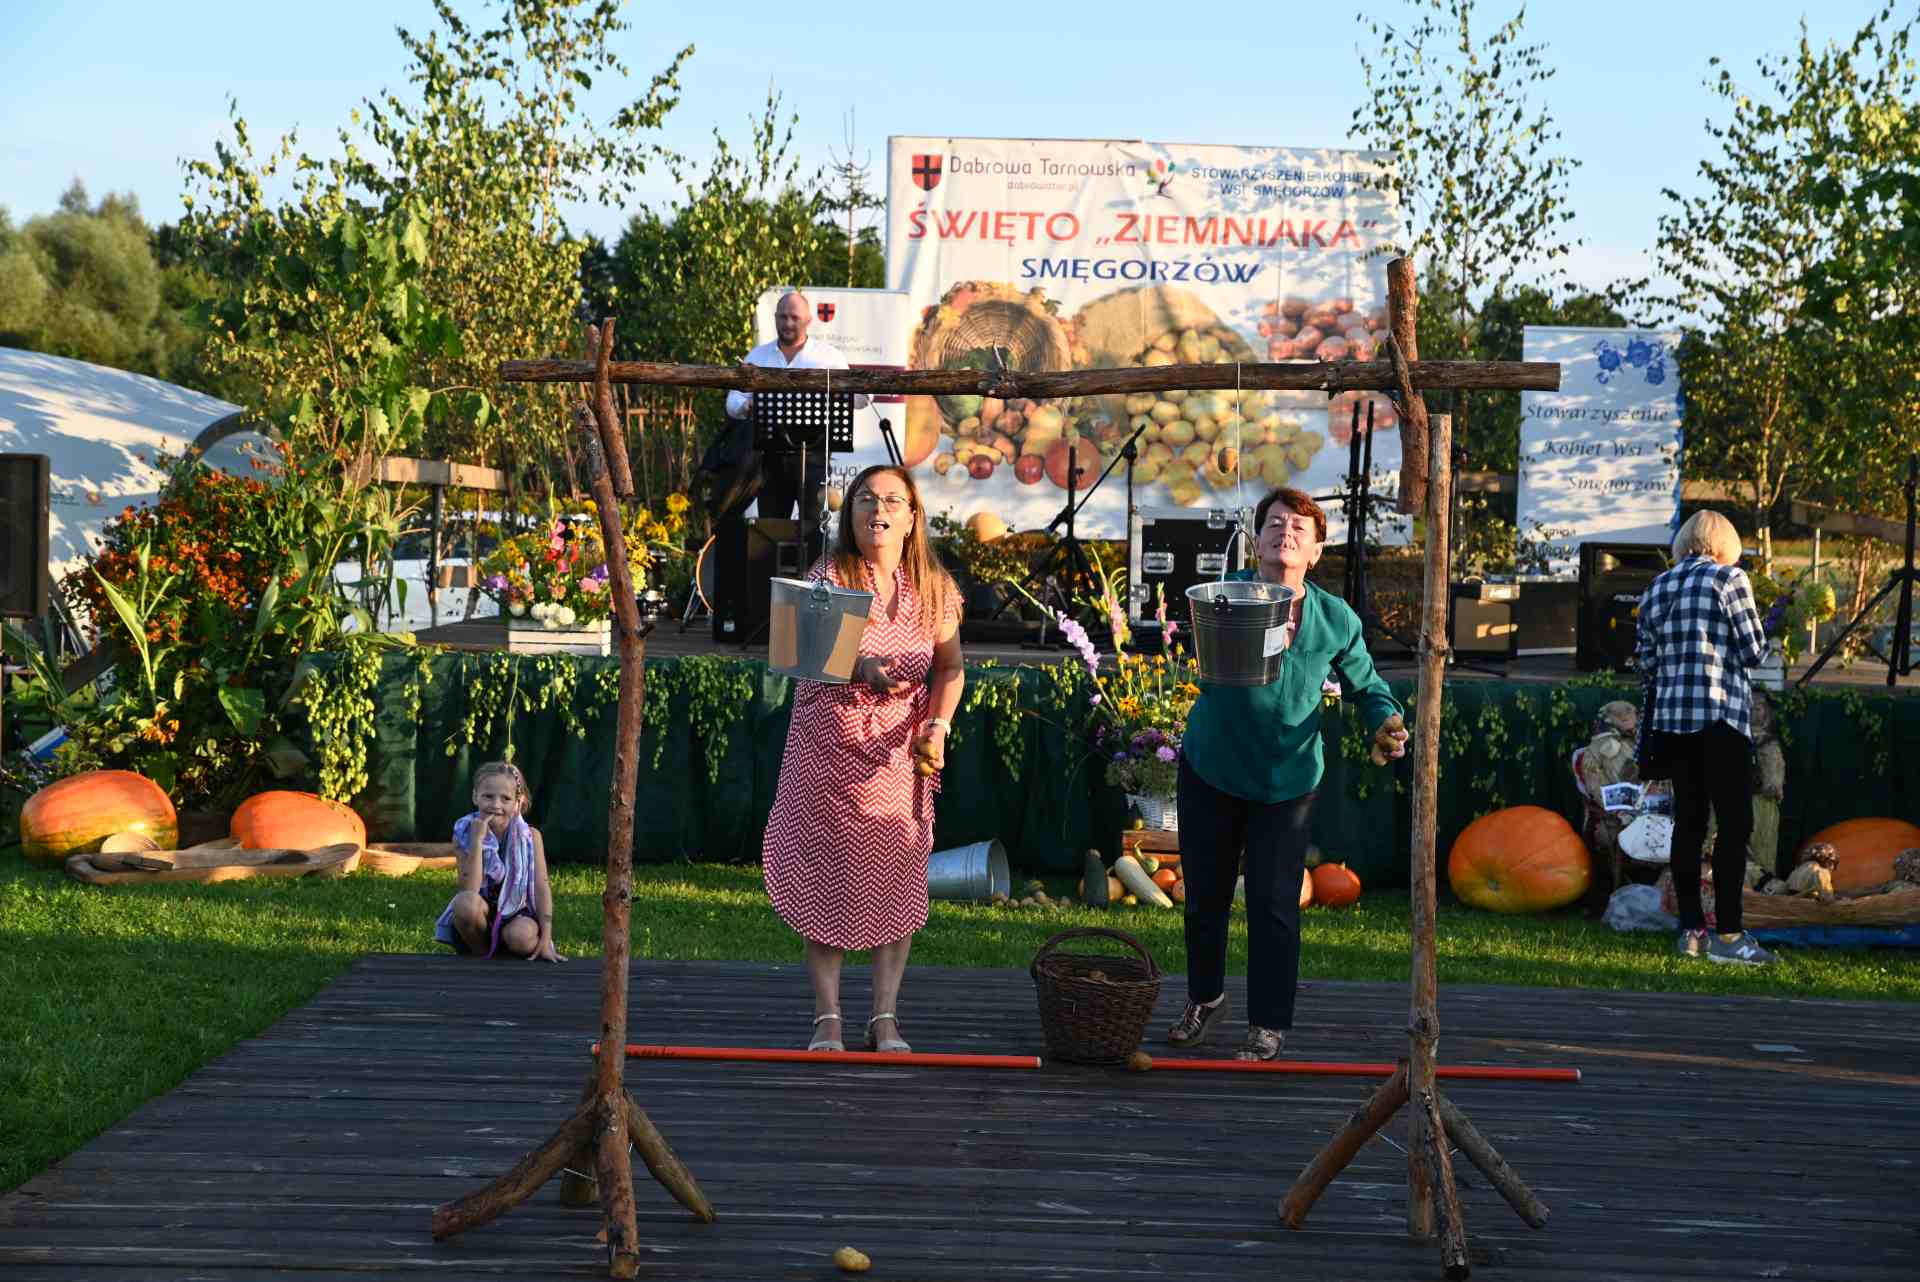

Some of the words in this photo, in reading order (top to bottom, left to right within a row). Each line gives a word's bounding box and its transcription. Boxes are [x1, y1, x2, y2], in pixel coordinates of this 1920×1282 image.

[1039, 158, 1136, 177] Tarnowska
[908, 202, 1081, 246] ŚWIĘTO
[1021, 256, 1260, 284] SMĘGORZÓW
[1526, 403, 1670, 425] Stowarzyszenie
[1542, 439, 1601, 457] Kobiet
[1613, 440, 1643, 457] Wsi
